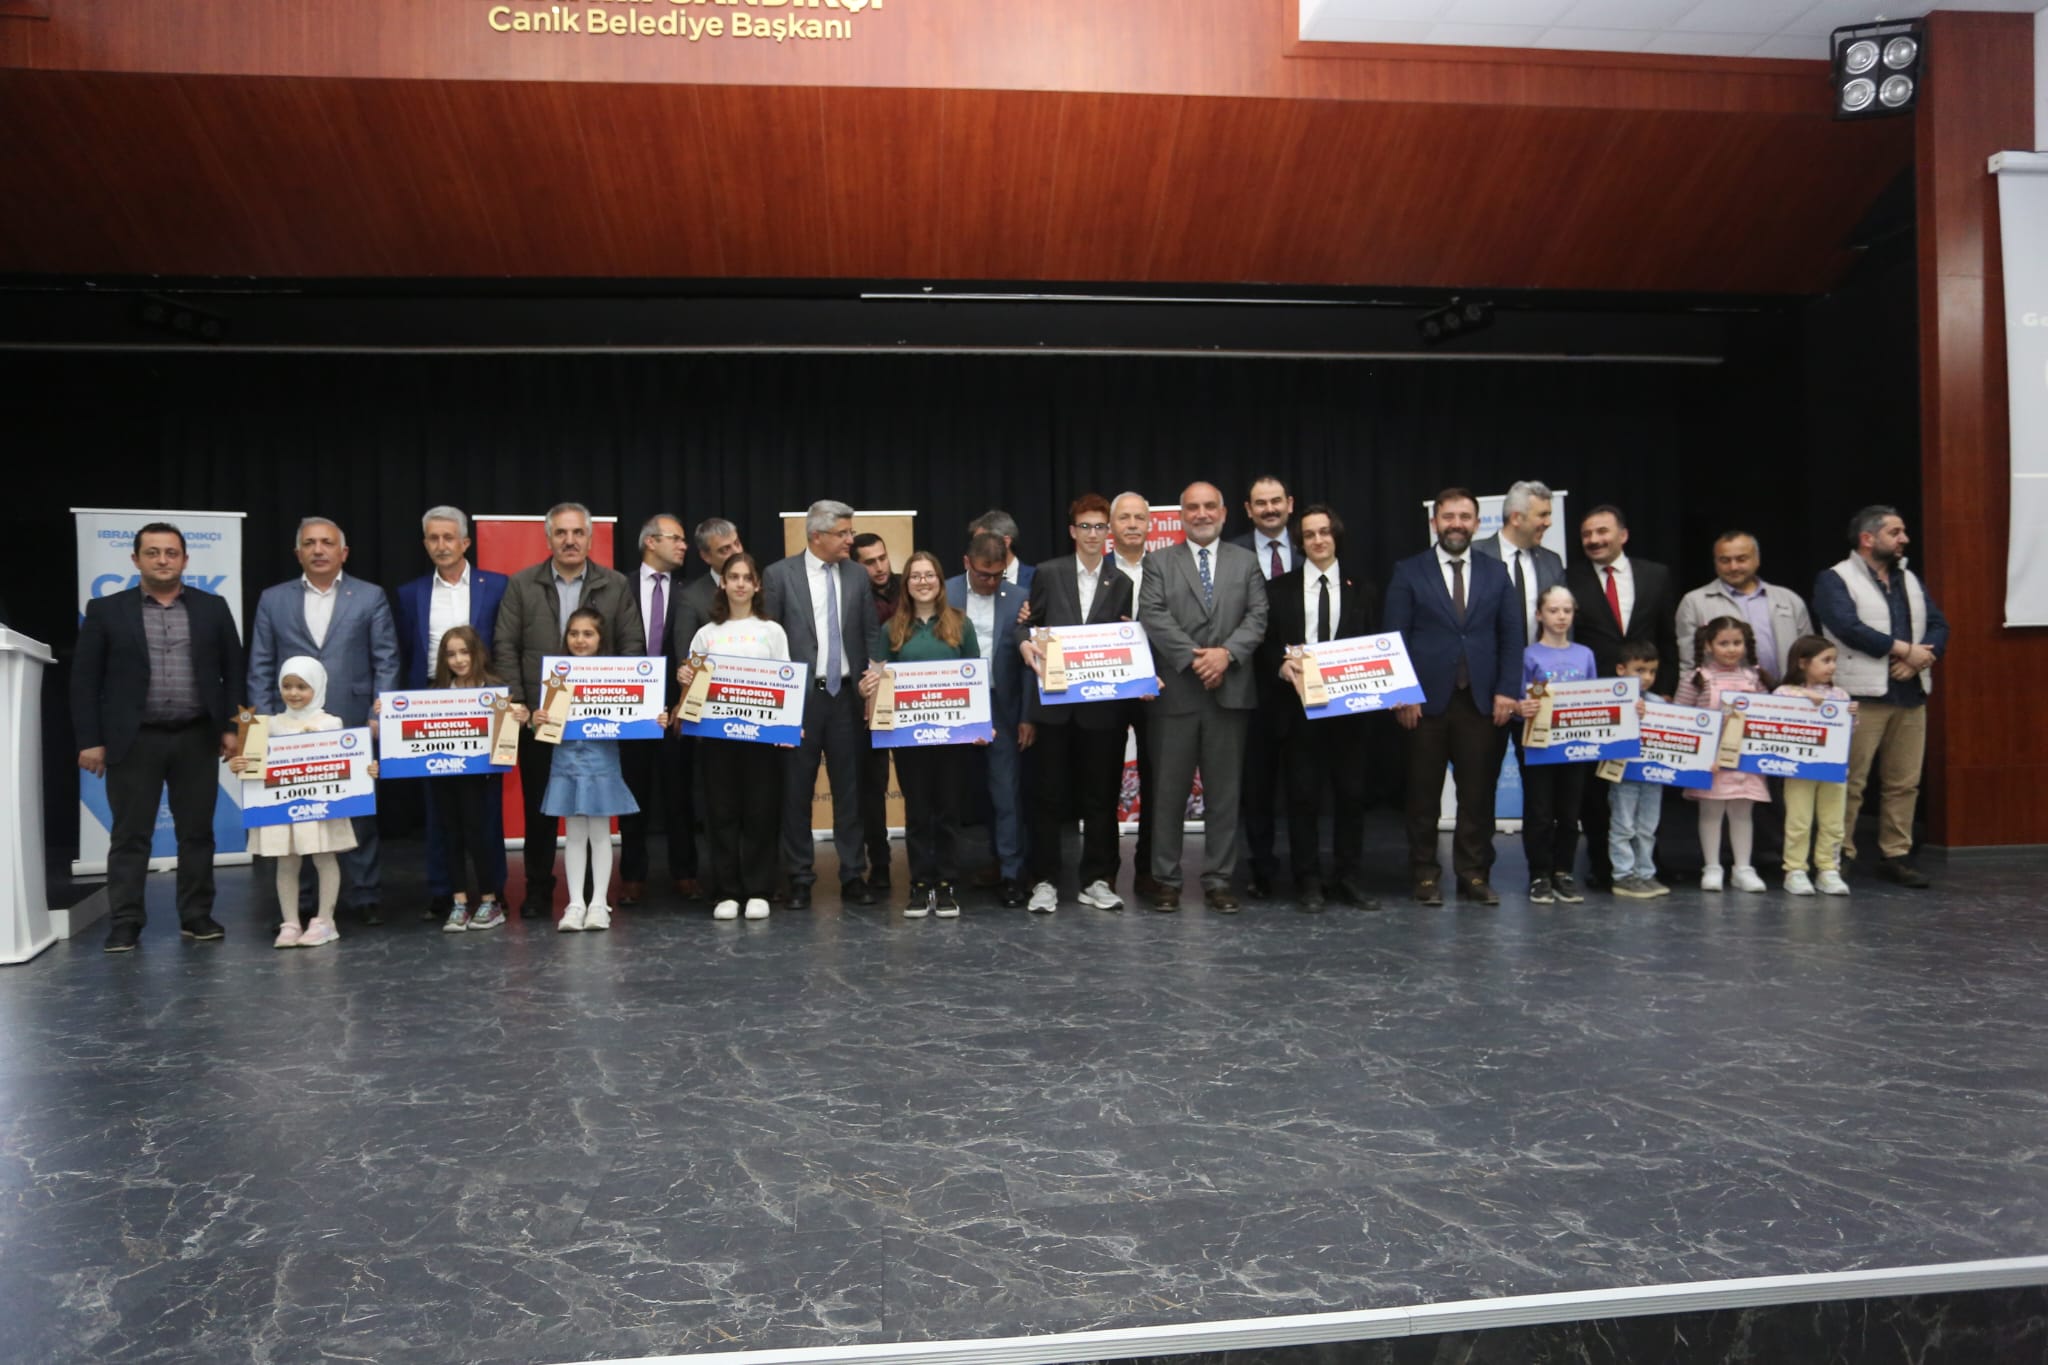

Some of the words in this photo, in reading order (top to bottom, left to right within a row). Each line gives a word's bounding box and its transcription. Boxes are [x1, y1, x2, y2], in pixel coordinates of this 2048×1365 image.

[488, 6, 580, 32] Canik
[587, 9, 723, 41] Belediye
[731, 12, 851, 42] Başkanı
[1109, 668, 1130, 677] TL
[1371, 680, 1392, 688] TL
[721, 687, 774, 697] ORTAOKUL
[616, 707, 637, 716] TL
[712, 705, 752, 717] 2.500
[757, 709, 776, 720] TL
[900, 712, 939, 723] 2.000
[945, 711, 965, 720] TL
[424, 720, 471, 729] İLKOKUL
[428, 728, 479, 738] BİRİNCİSİ
[1552, 729, 1591, 740] 2.000
[1595, 728, 1616, 737] TL
[411, 742, 455, 752] 2.000
[460, 740, 483, 750] TL
[1747, 742, 1790, 754] 1.500
[1796, 746, 1818, 757] TL
[1668, 753, 1687, 764] TL
[272, 767, 303, 777] OKUL
[305, 762, 345, 774] ÖNCESİ
[275, 786, 316, 800] 1.000
[322, 784, 346, 795] TL
